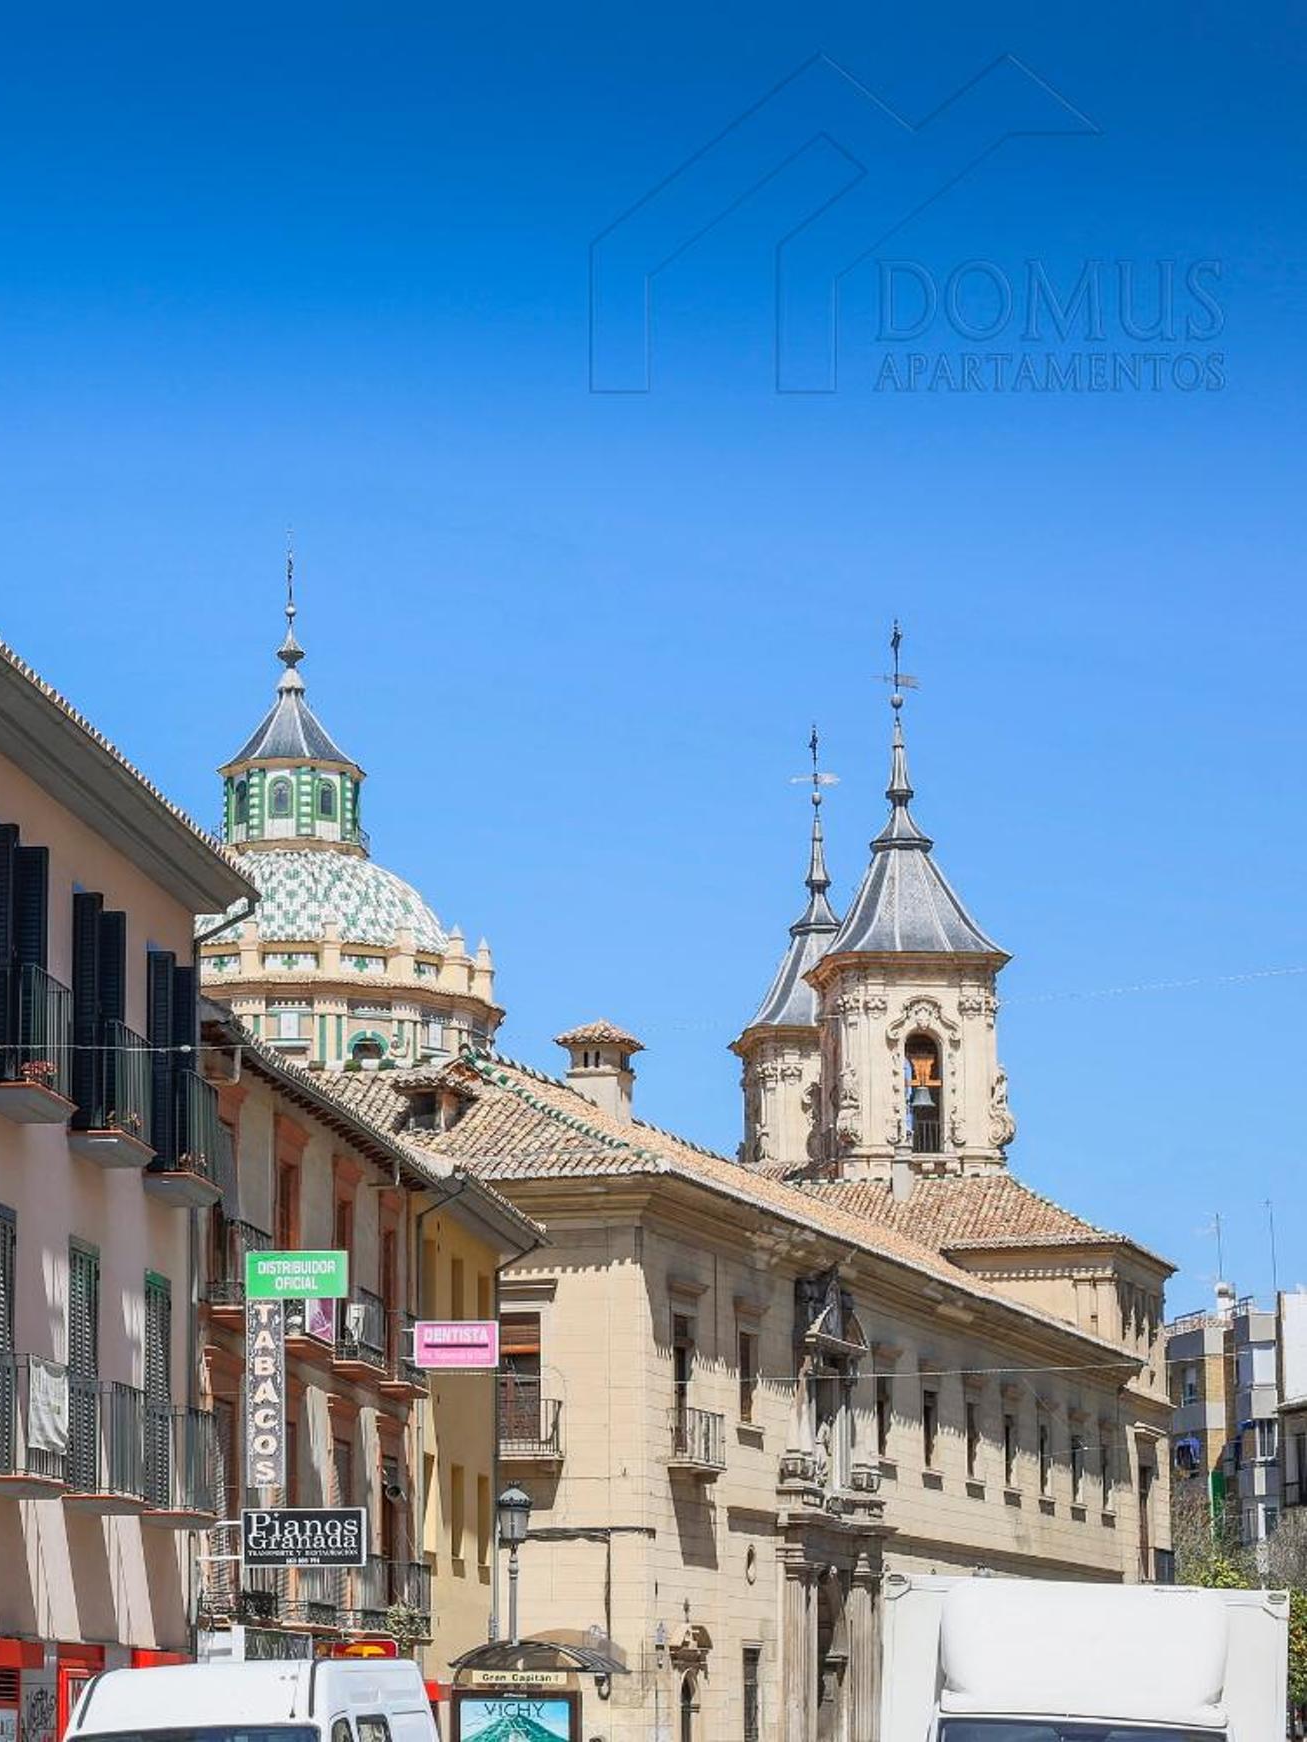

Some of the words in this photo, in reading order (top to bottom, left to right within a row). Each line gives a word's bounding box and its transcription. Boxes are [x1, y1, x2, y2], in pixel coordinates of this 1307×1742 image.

[257, 1260, 337, 1275] DISTRIBUIDOR
[275, 1275, 318, 1291] OFICIAL
[423, 1326, 489, 1344] DENTISTA
[253, 1304, 279, 1482] TABACOS
[247, 1512, 359, 1538] Pianos
[248, 1529, 358, 1550] Granada
[482, 1673, 507, 1682] Gran
[511, 1673, 552, 1682] Capitán
[484, 1702, 545, 1719] VICHY
